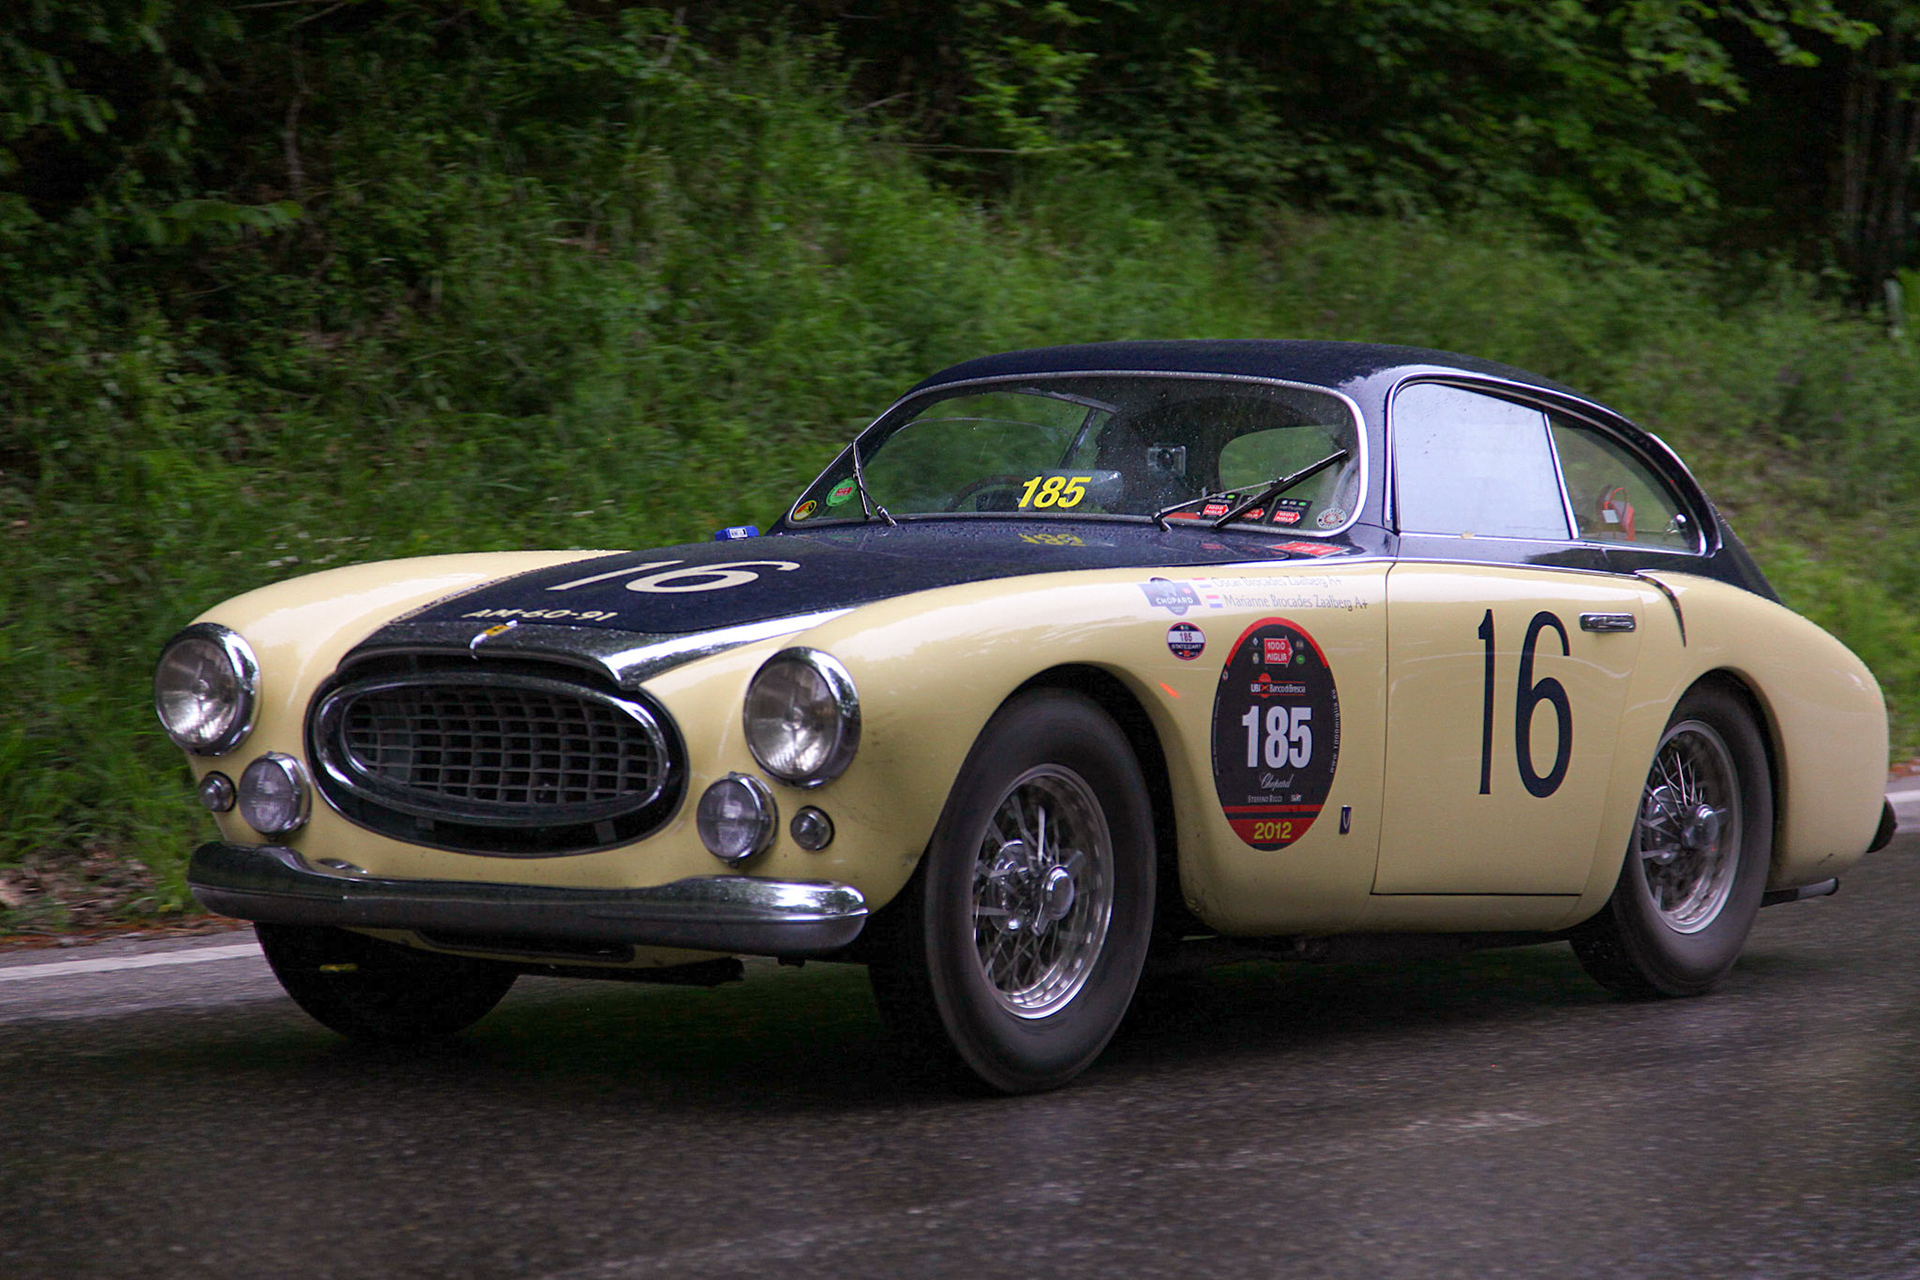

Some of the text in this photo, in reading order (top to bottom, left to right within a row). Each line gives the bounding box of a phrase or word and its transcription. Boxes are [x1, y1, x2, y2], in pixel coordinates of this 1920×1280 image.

[1017, 475, 1092, 508] 185
[545, 559, 801, 594] 16
[1155, 596, 1194, 605] CHOPARD
[1224, 594, 1270, 608] Marianne
[1270, 594, 1314, 609] Brocades
[1314, 594, 1354, 612] Zaalberg
[461, 608, 619, 622] AM-60-91
[1179, 632, 1193, 642] 185
[1267, 641, 1286, 650] 1000
[1266, 653, 1287, 662] MIGLIA
[1250, 683, 1261, 693] UBI
[1477, 608, 1574, 799] 16
[1241, 705, 1314, 769] 185
[1259, 772, 1295, 792] Chopard
[1254, 821, 1293, 840] 2012
